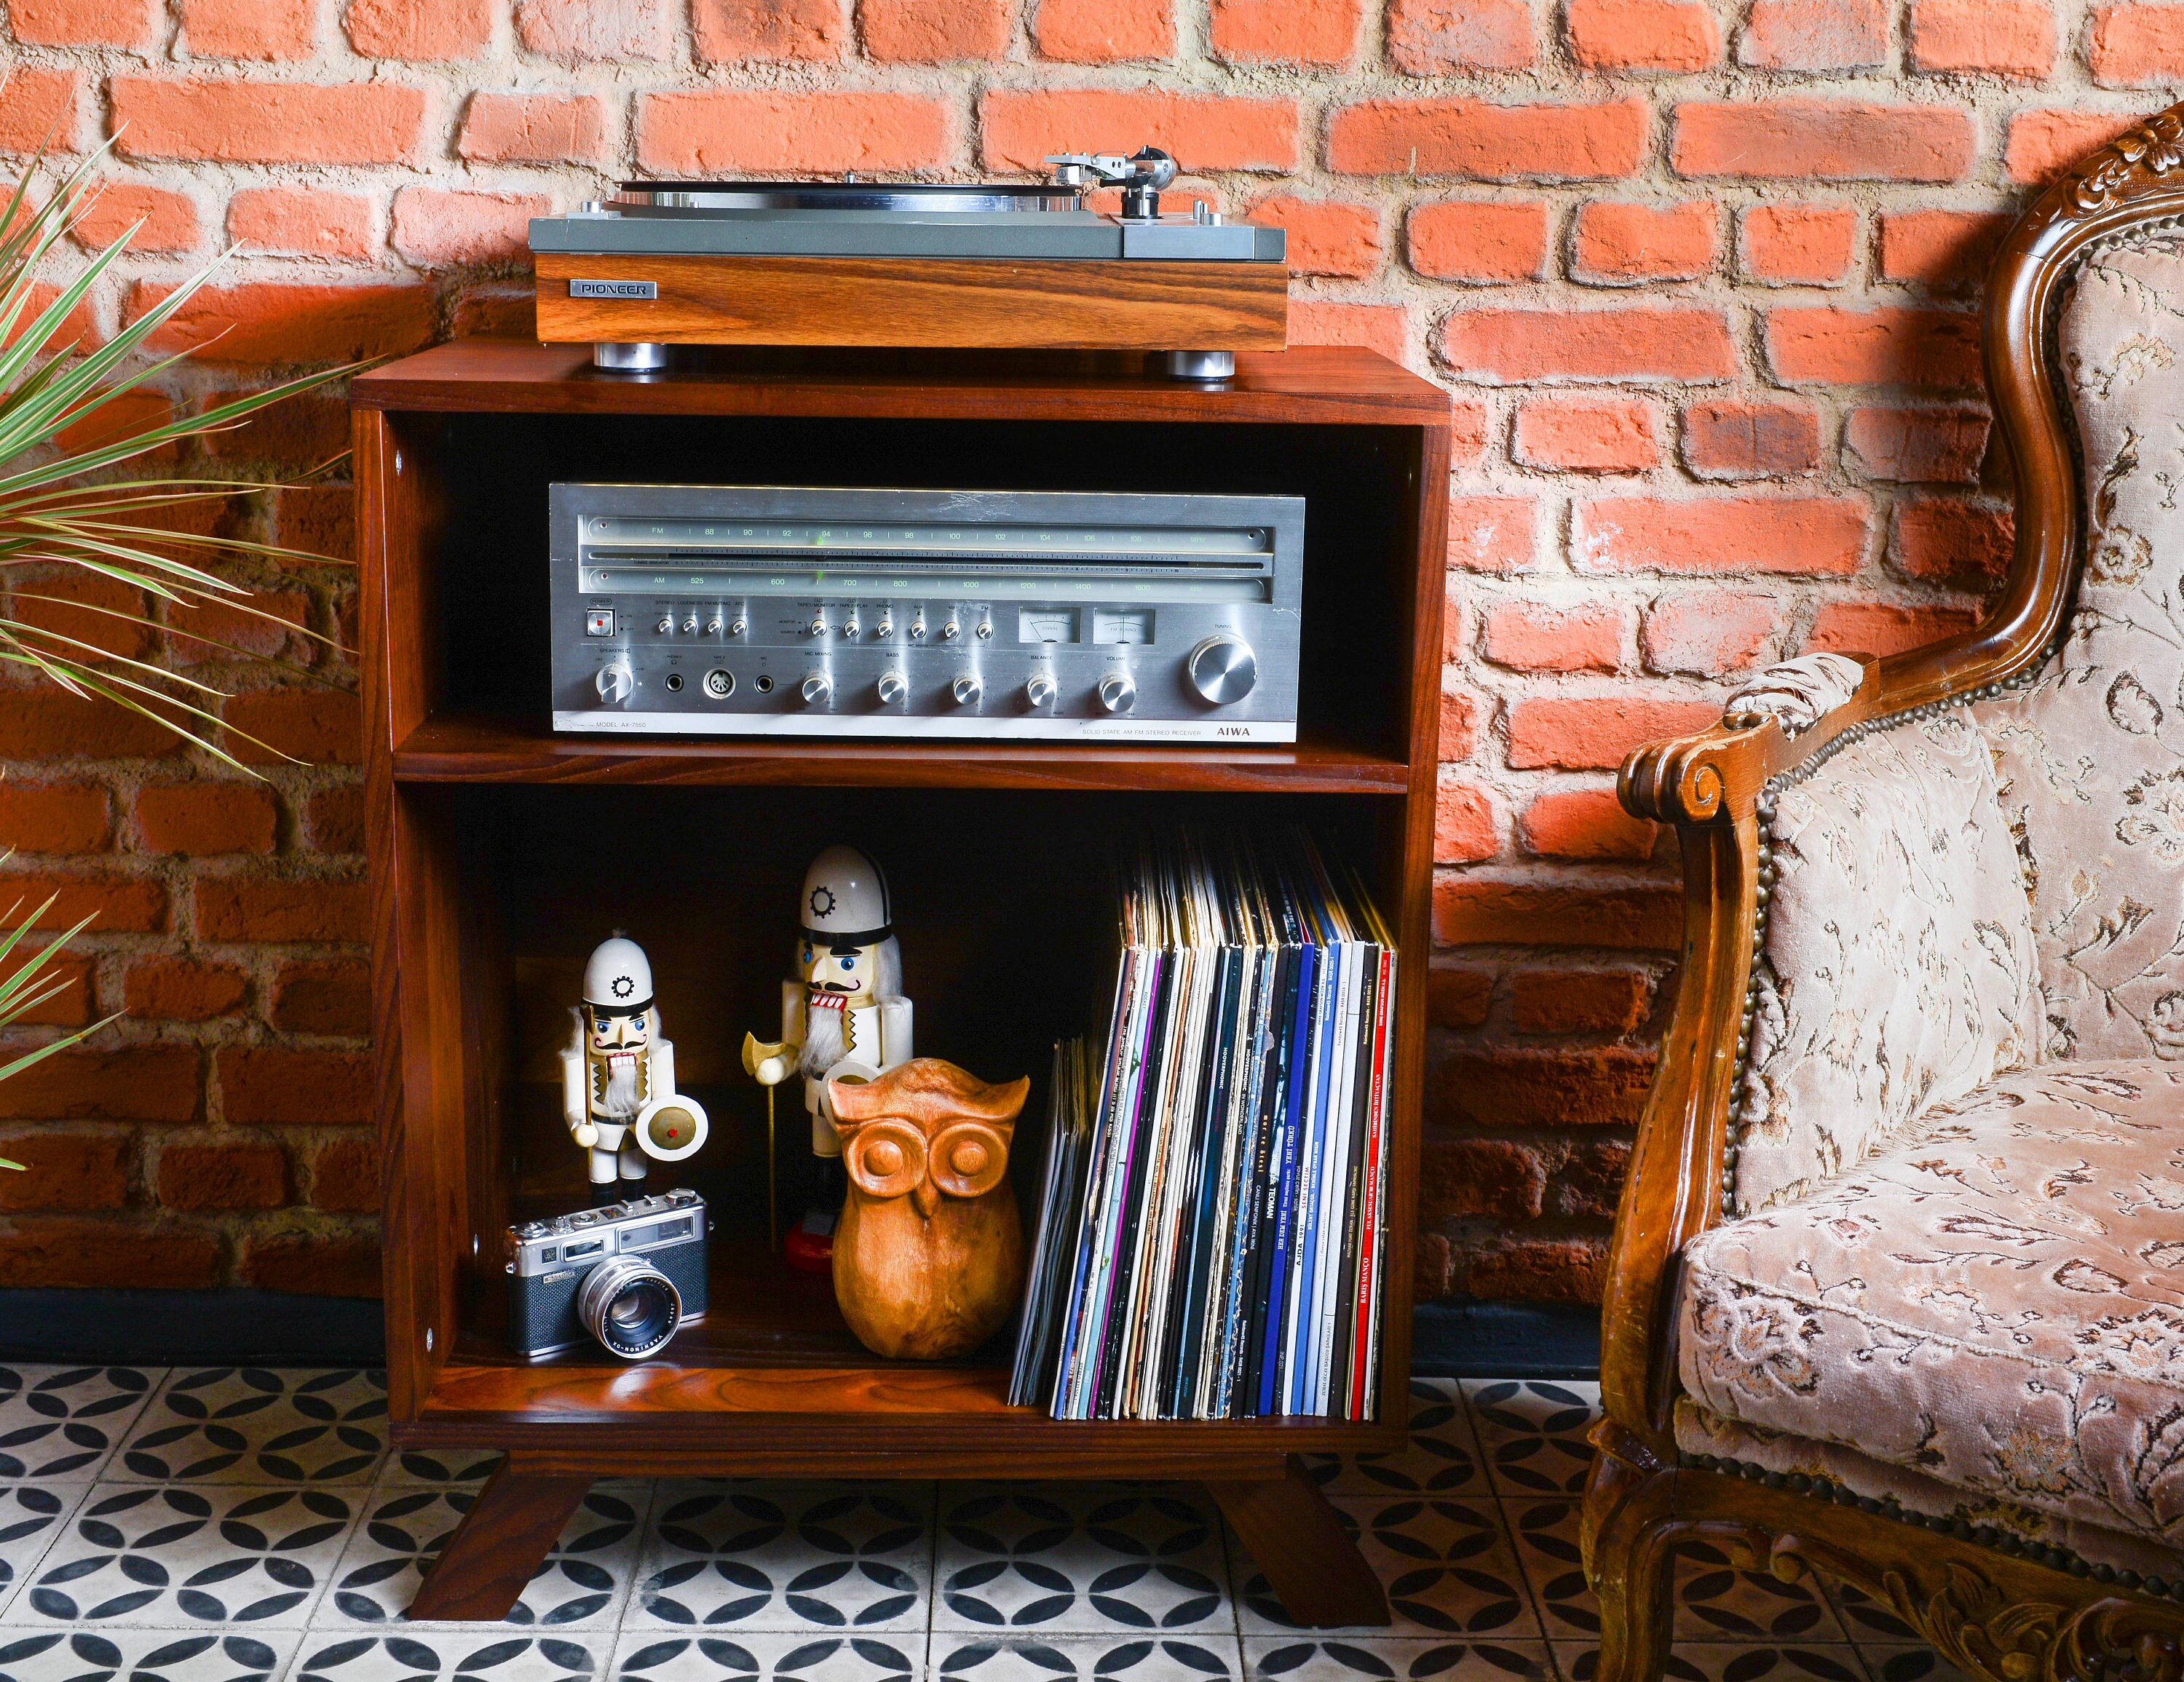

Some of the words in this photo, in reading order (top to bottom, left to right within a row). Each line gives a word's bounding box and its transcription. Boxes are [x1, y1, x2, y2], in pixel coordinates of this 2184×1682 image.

[581, 285, 646, 295] PIONEER
[1217, 727, 1250, 737] AIWA
[1219, 1047, 1227, 1089] HOOVERPHONIC
[1242, 1048, 1251, 1091] HOOVERPHONIC
[1237, 1098, 1245, 1134] WONDERLAND
[1260, 1135, 1265, 1145] ve
[1286, 1125, 1295, 1147] TÜRKÜ
[1285, 1149, 1293, 1164] YENİ
[1266, 1187, 1275, 1218] TEOMAN
[1361, 1257, 1369, 1282] MANÇO
[1360, 1283, 1368, 1303] BARIŞ
[613, 1335, 663, 1352] YASHINON-DX
